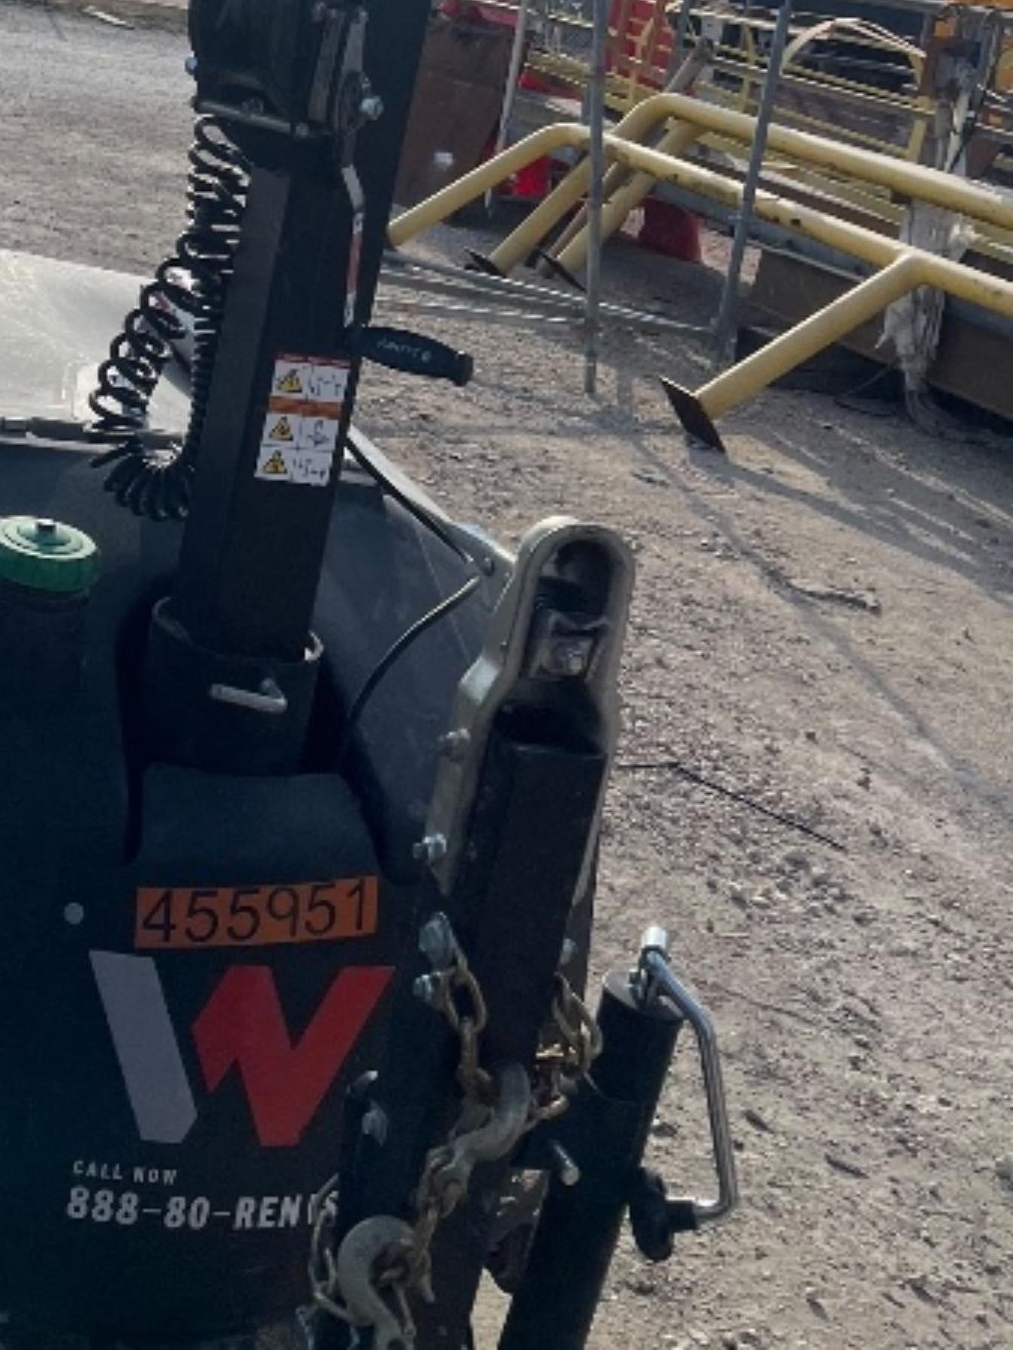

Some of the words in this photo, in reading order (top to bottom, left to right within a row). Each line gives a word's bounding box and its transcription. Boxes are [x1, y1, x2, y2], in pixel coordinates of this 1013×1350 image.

[142, 880, 367, 943] 455951
[73, 1160, 123, 1180] CALL
[132, 1167, 178, 1186] NOW
